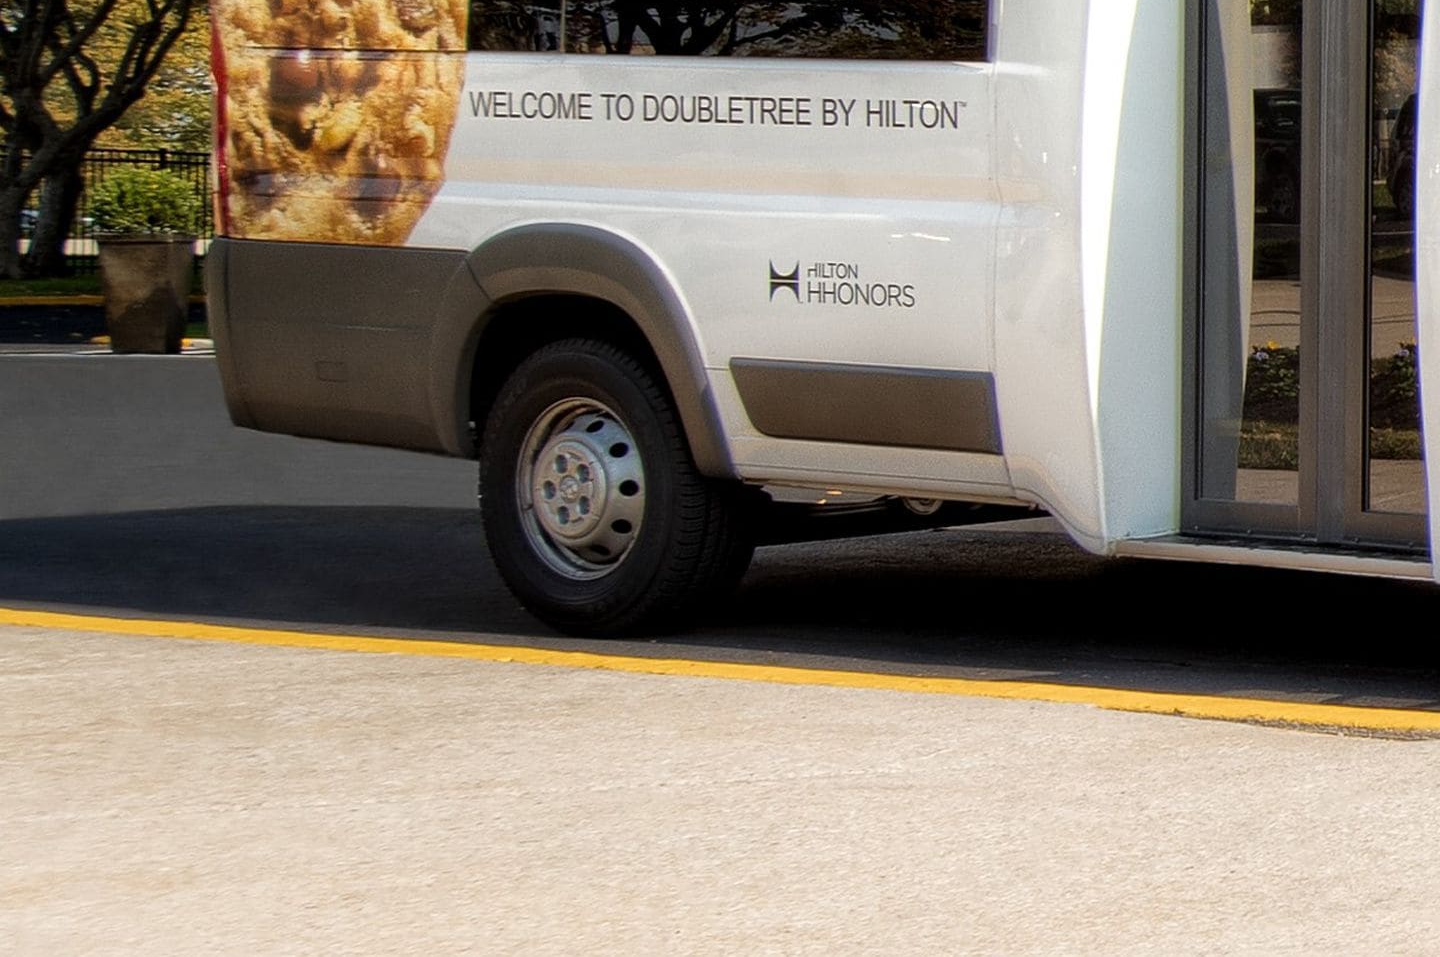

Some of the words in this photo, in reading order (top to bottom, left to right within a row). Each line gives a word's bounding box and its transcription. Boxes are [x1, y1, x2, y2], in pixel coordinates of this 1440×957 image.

[468, 91, 593, 120] WELCOME
[600, 93, 634, 121] TO
[643, 94, 812, 126] DOUBLETREE
[822, 98, 857, 127] BY
[807, 262, 858, 279] HILTON
[807, 281, 916, 308] HHONORS
